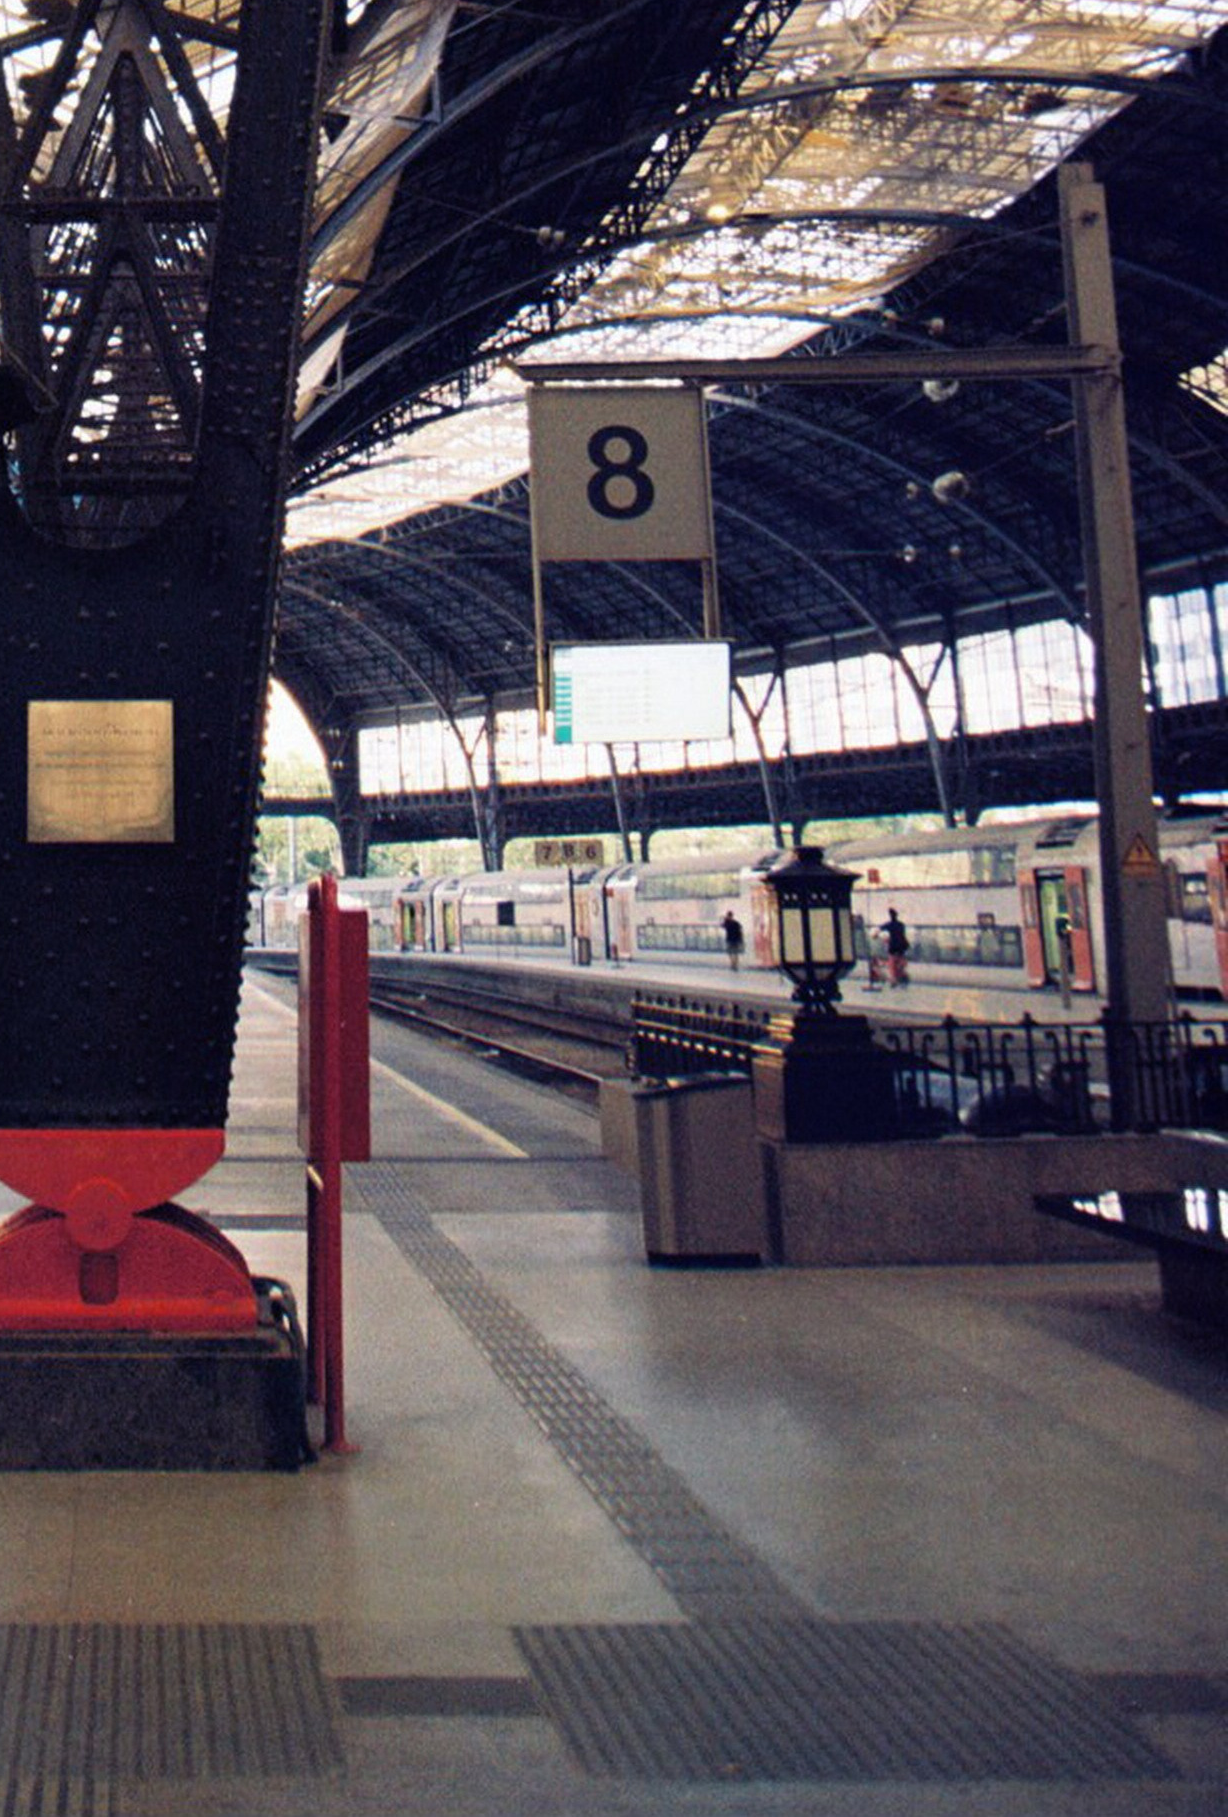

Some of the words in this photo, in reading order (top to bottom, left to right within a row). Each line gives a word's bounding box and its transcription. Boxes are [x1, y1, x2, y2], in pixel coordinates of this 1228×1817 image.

[587, 425, 655, 520] 8
[541, 844, 552, 860] 7
[585, 844, 597, 860] 6
